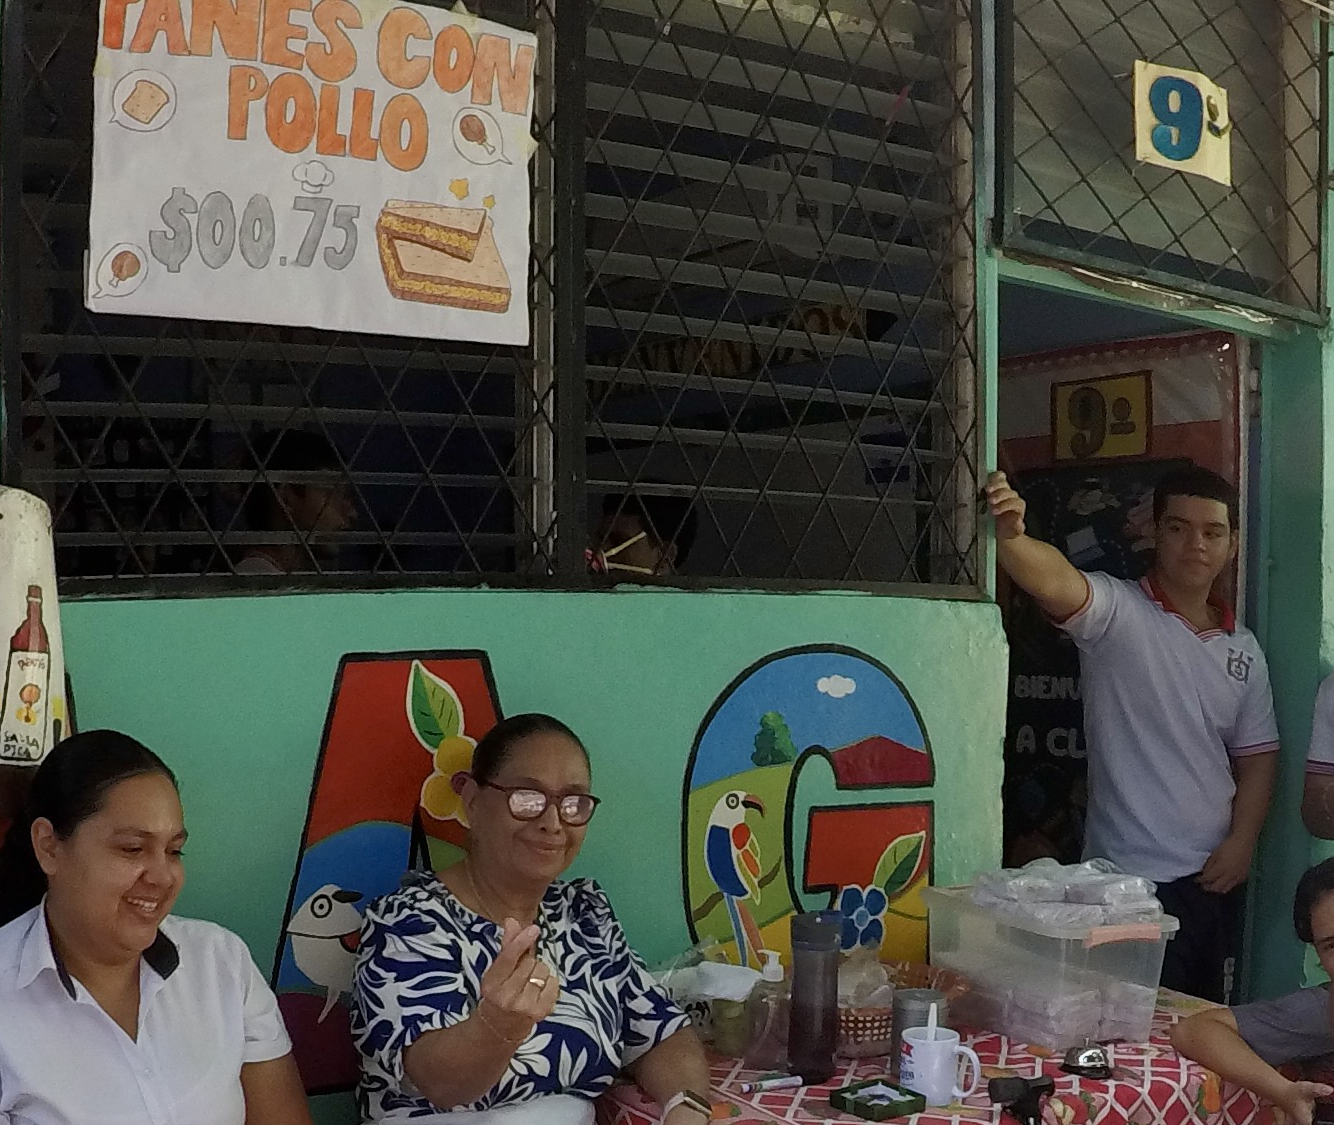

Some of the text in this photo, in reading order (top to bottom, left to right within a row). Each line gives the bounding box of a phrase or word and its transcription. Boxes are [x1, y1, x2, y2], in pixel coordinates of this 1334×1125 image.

[376, 6, 536, 115] CON
[227, 64, 429, 171] POLLO
[149, 187, 360, 273] $00.75
[1016, 724, 1036, 753] A
